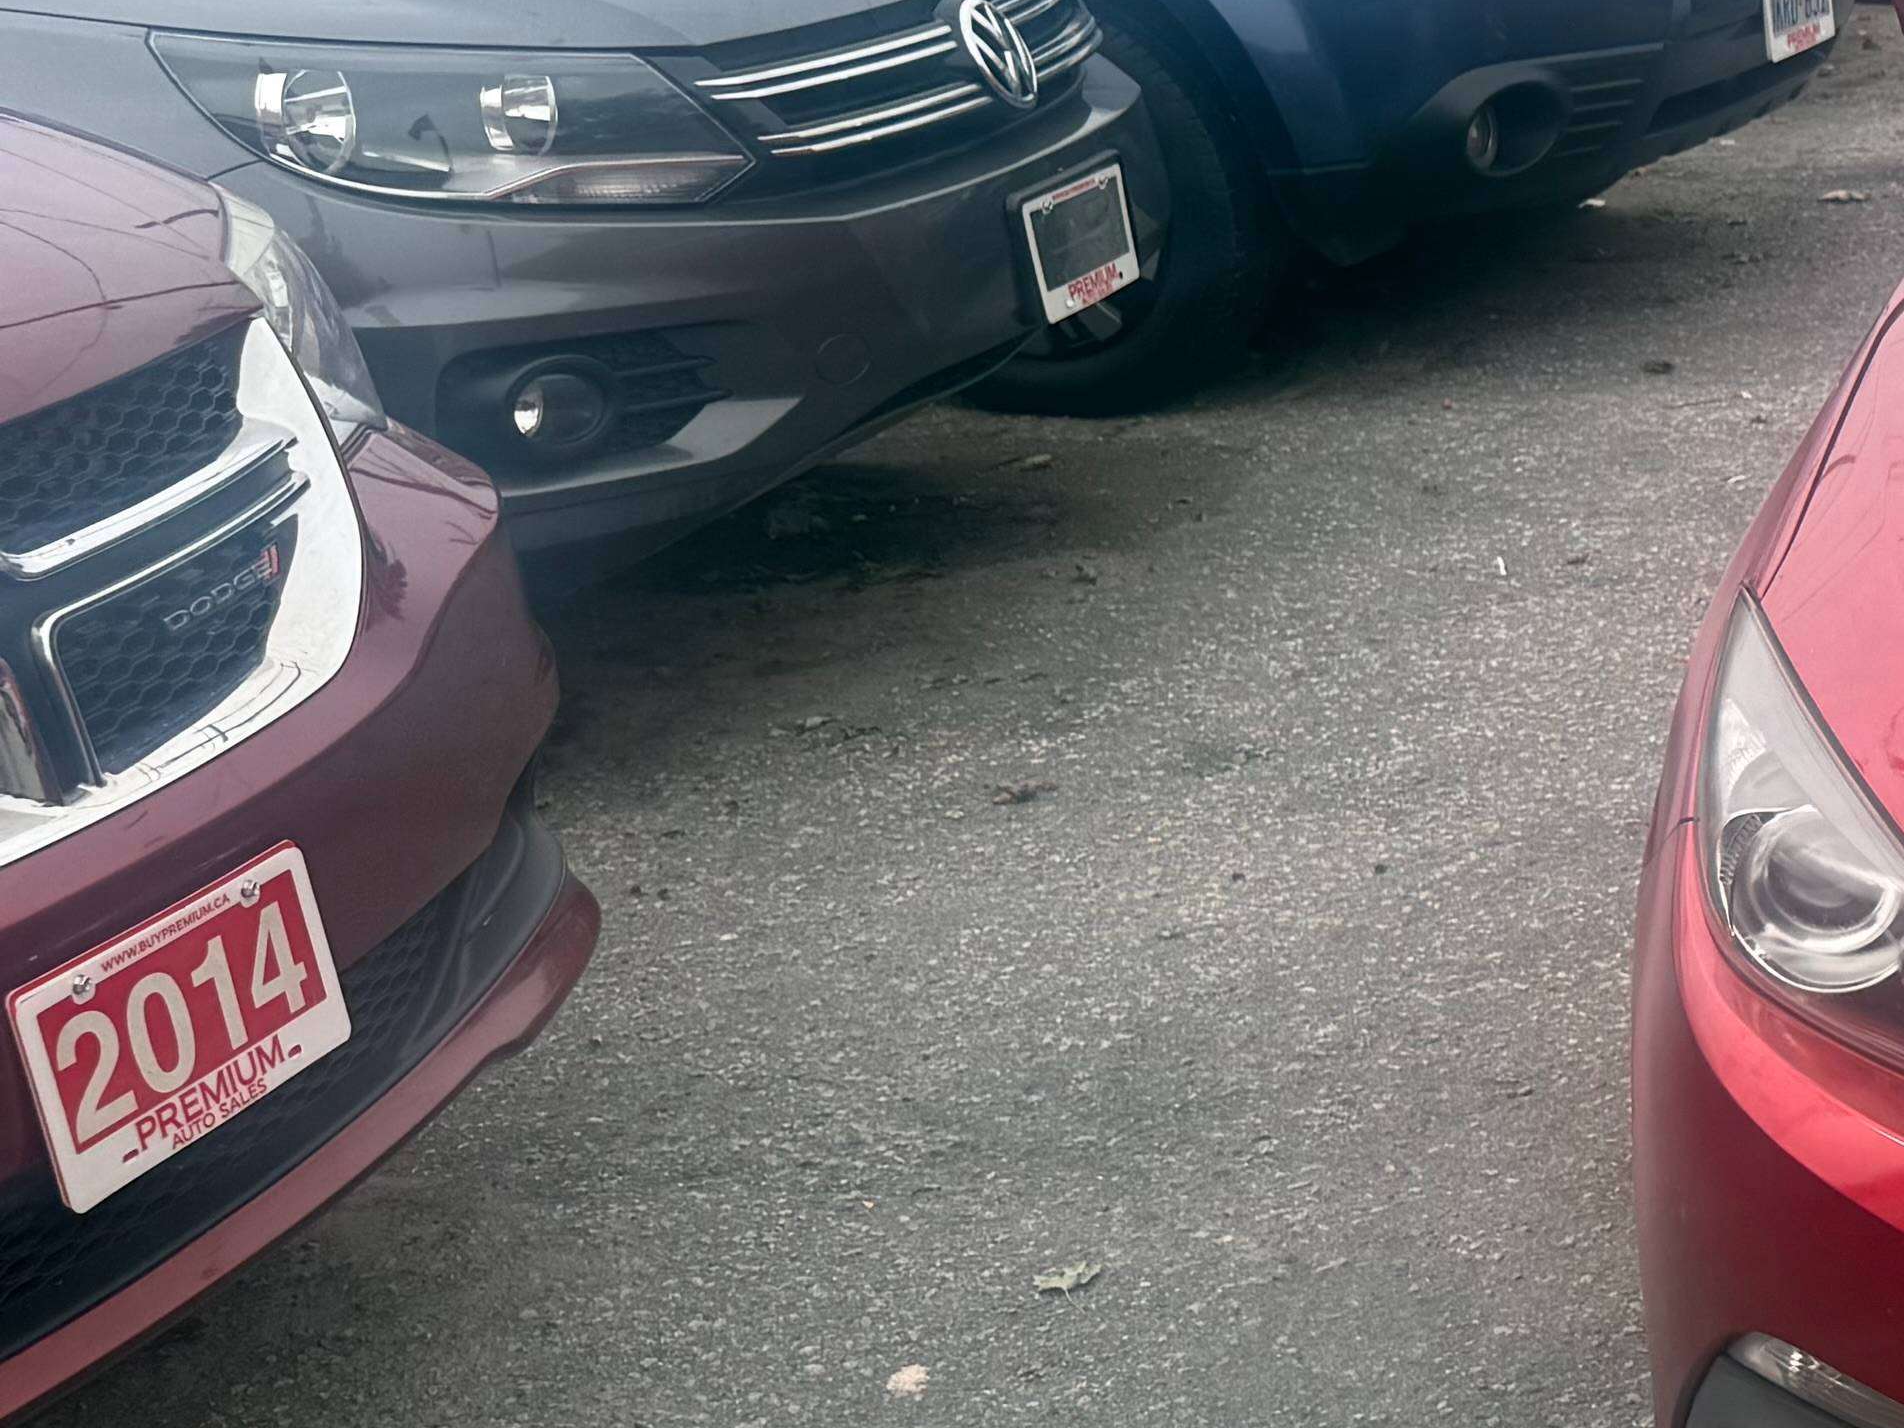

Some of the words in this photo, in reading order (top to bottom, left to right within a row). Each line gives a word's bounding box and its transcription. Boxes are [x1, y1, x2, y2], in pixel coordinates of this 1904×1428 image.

[1068, 263, 1120, 299] PREMIUM
[163, 558, 272, 631] DODGE
[100, 893, 231, 973] WWW.BUYPREMIUM.CA
[56, 900, 308, 1145] 2014
[137, 1035, 286, 1151] PREMIUM
[172, 1110, 215, 1150] AUTO
[221, 1077, 268, 1118] SALES
